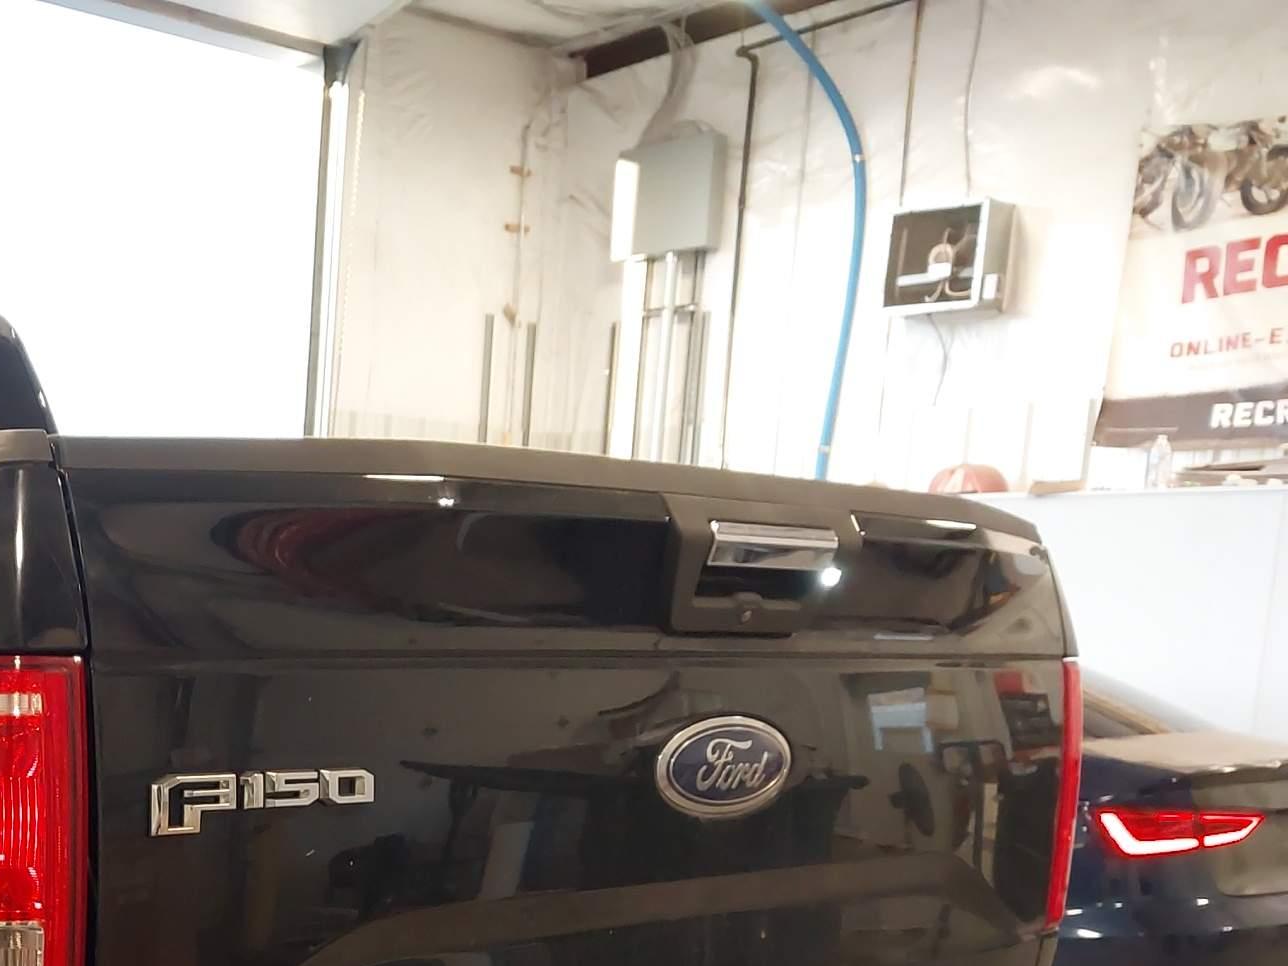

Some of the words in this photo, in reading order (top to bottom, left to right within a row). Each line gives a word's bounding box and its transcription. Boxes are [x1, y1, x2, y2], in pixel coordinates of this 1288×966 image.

[1170, 327, 1288, 358] ONLINE-E
[695, 738, 768, 791] Ford
[151, 769, 375, 836] F150
